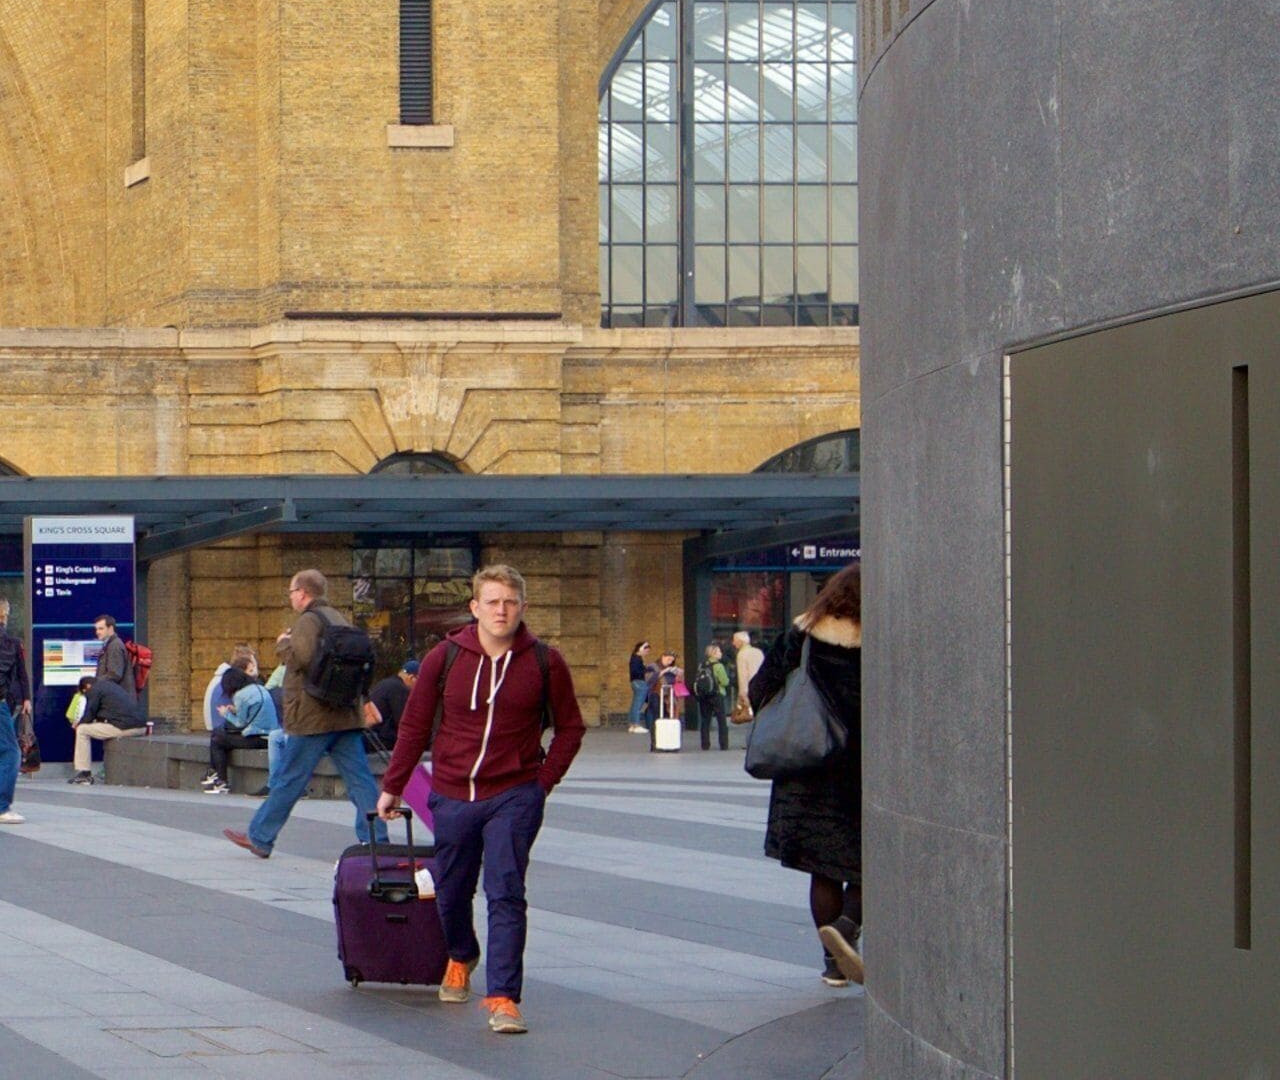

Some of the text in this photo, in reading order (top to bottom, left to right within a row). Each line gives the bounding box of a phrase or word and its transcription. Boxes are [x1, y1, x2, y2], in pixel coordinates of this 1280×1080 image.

[40, 526, 126, 534] KING'S CROSS SQUARE
[55, 566, 73, 574] King's
[55, 577, 96, 585] Underground
